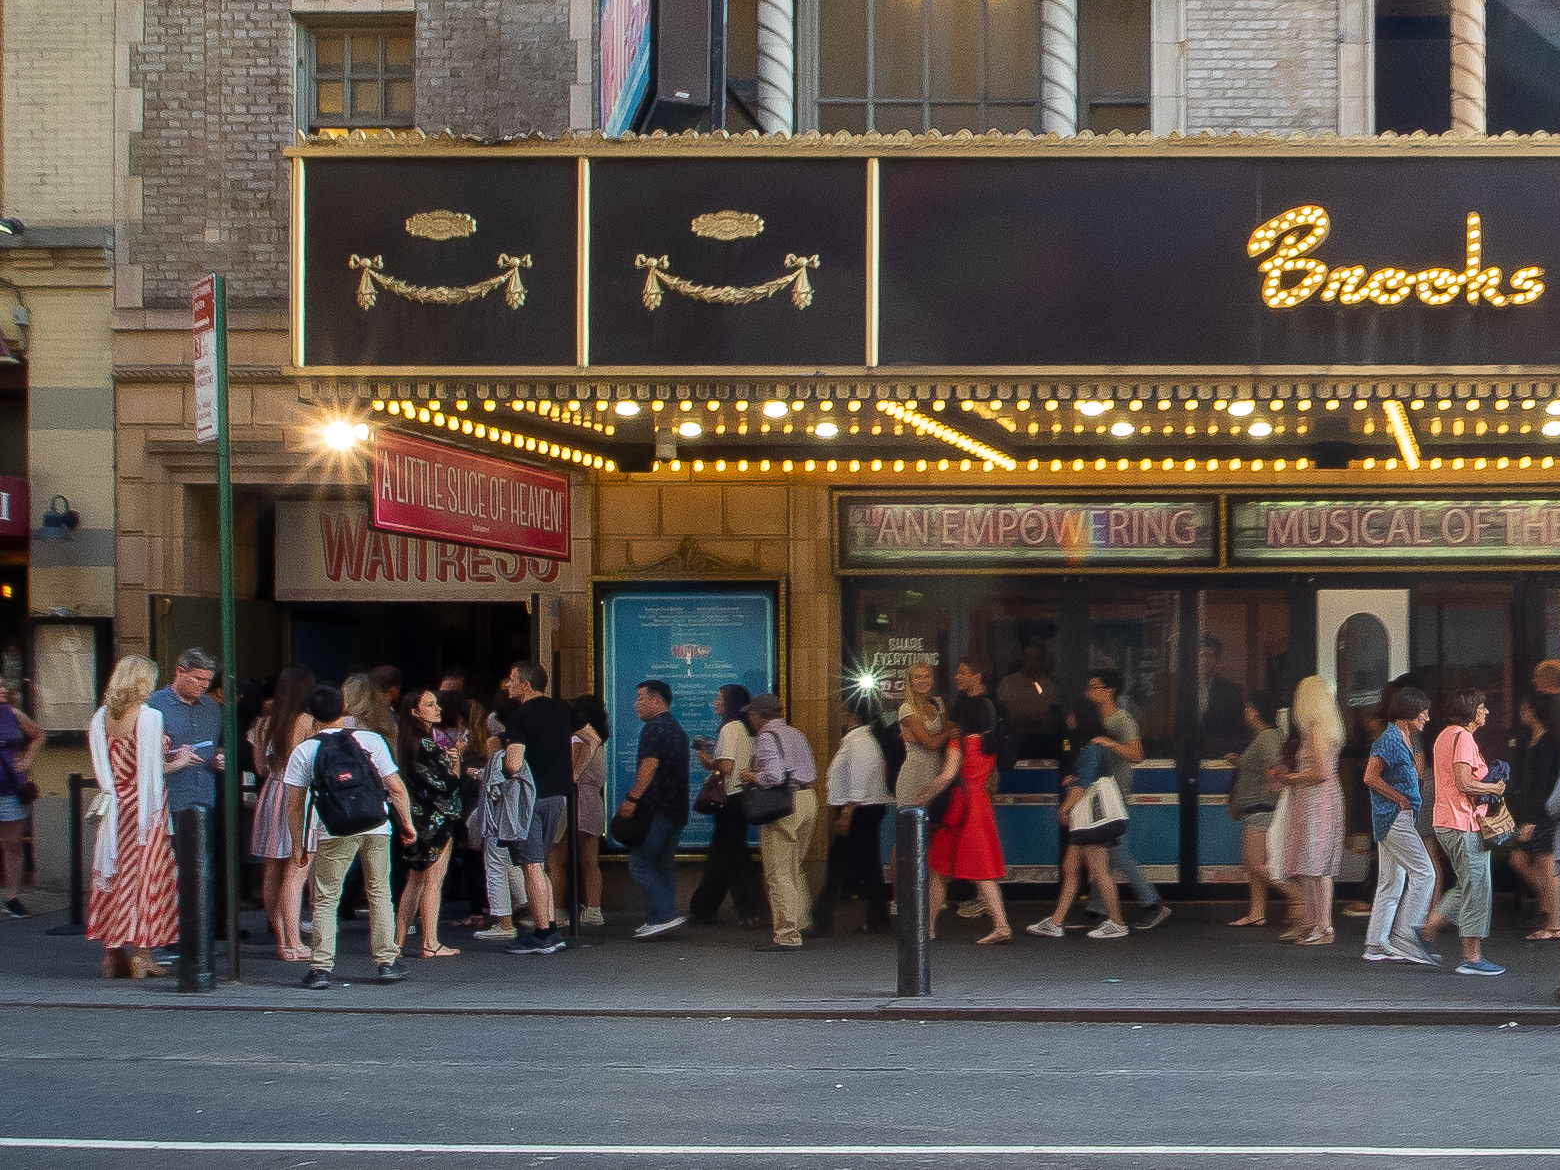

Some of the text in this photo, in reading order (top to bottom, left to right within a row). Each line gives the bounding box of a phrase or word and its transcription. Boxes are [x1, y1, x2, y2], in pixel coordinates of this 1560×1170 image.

[1246, 204, 1547, 309] Brooks
[395, 454, 444, 511] LITTLE
[447, 466, 487, 519] SLICE
[489, 476, 506, 522] OF
[941, 507, 1199, 546] EMPOWERING
[1266, 507, 1434, 547] MUSICAL
[1442, 507, 1491, 546] OF
